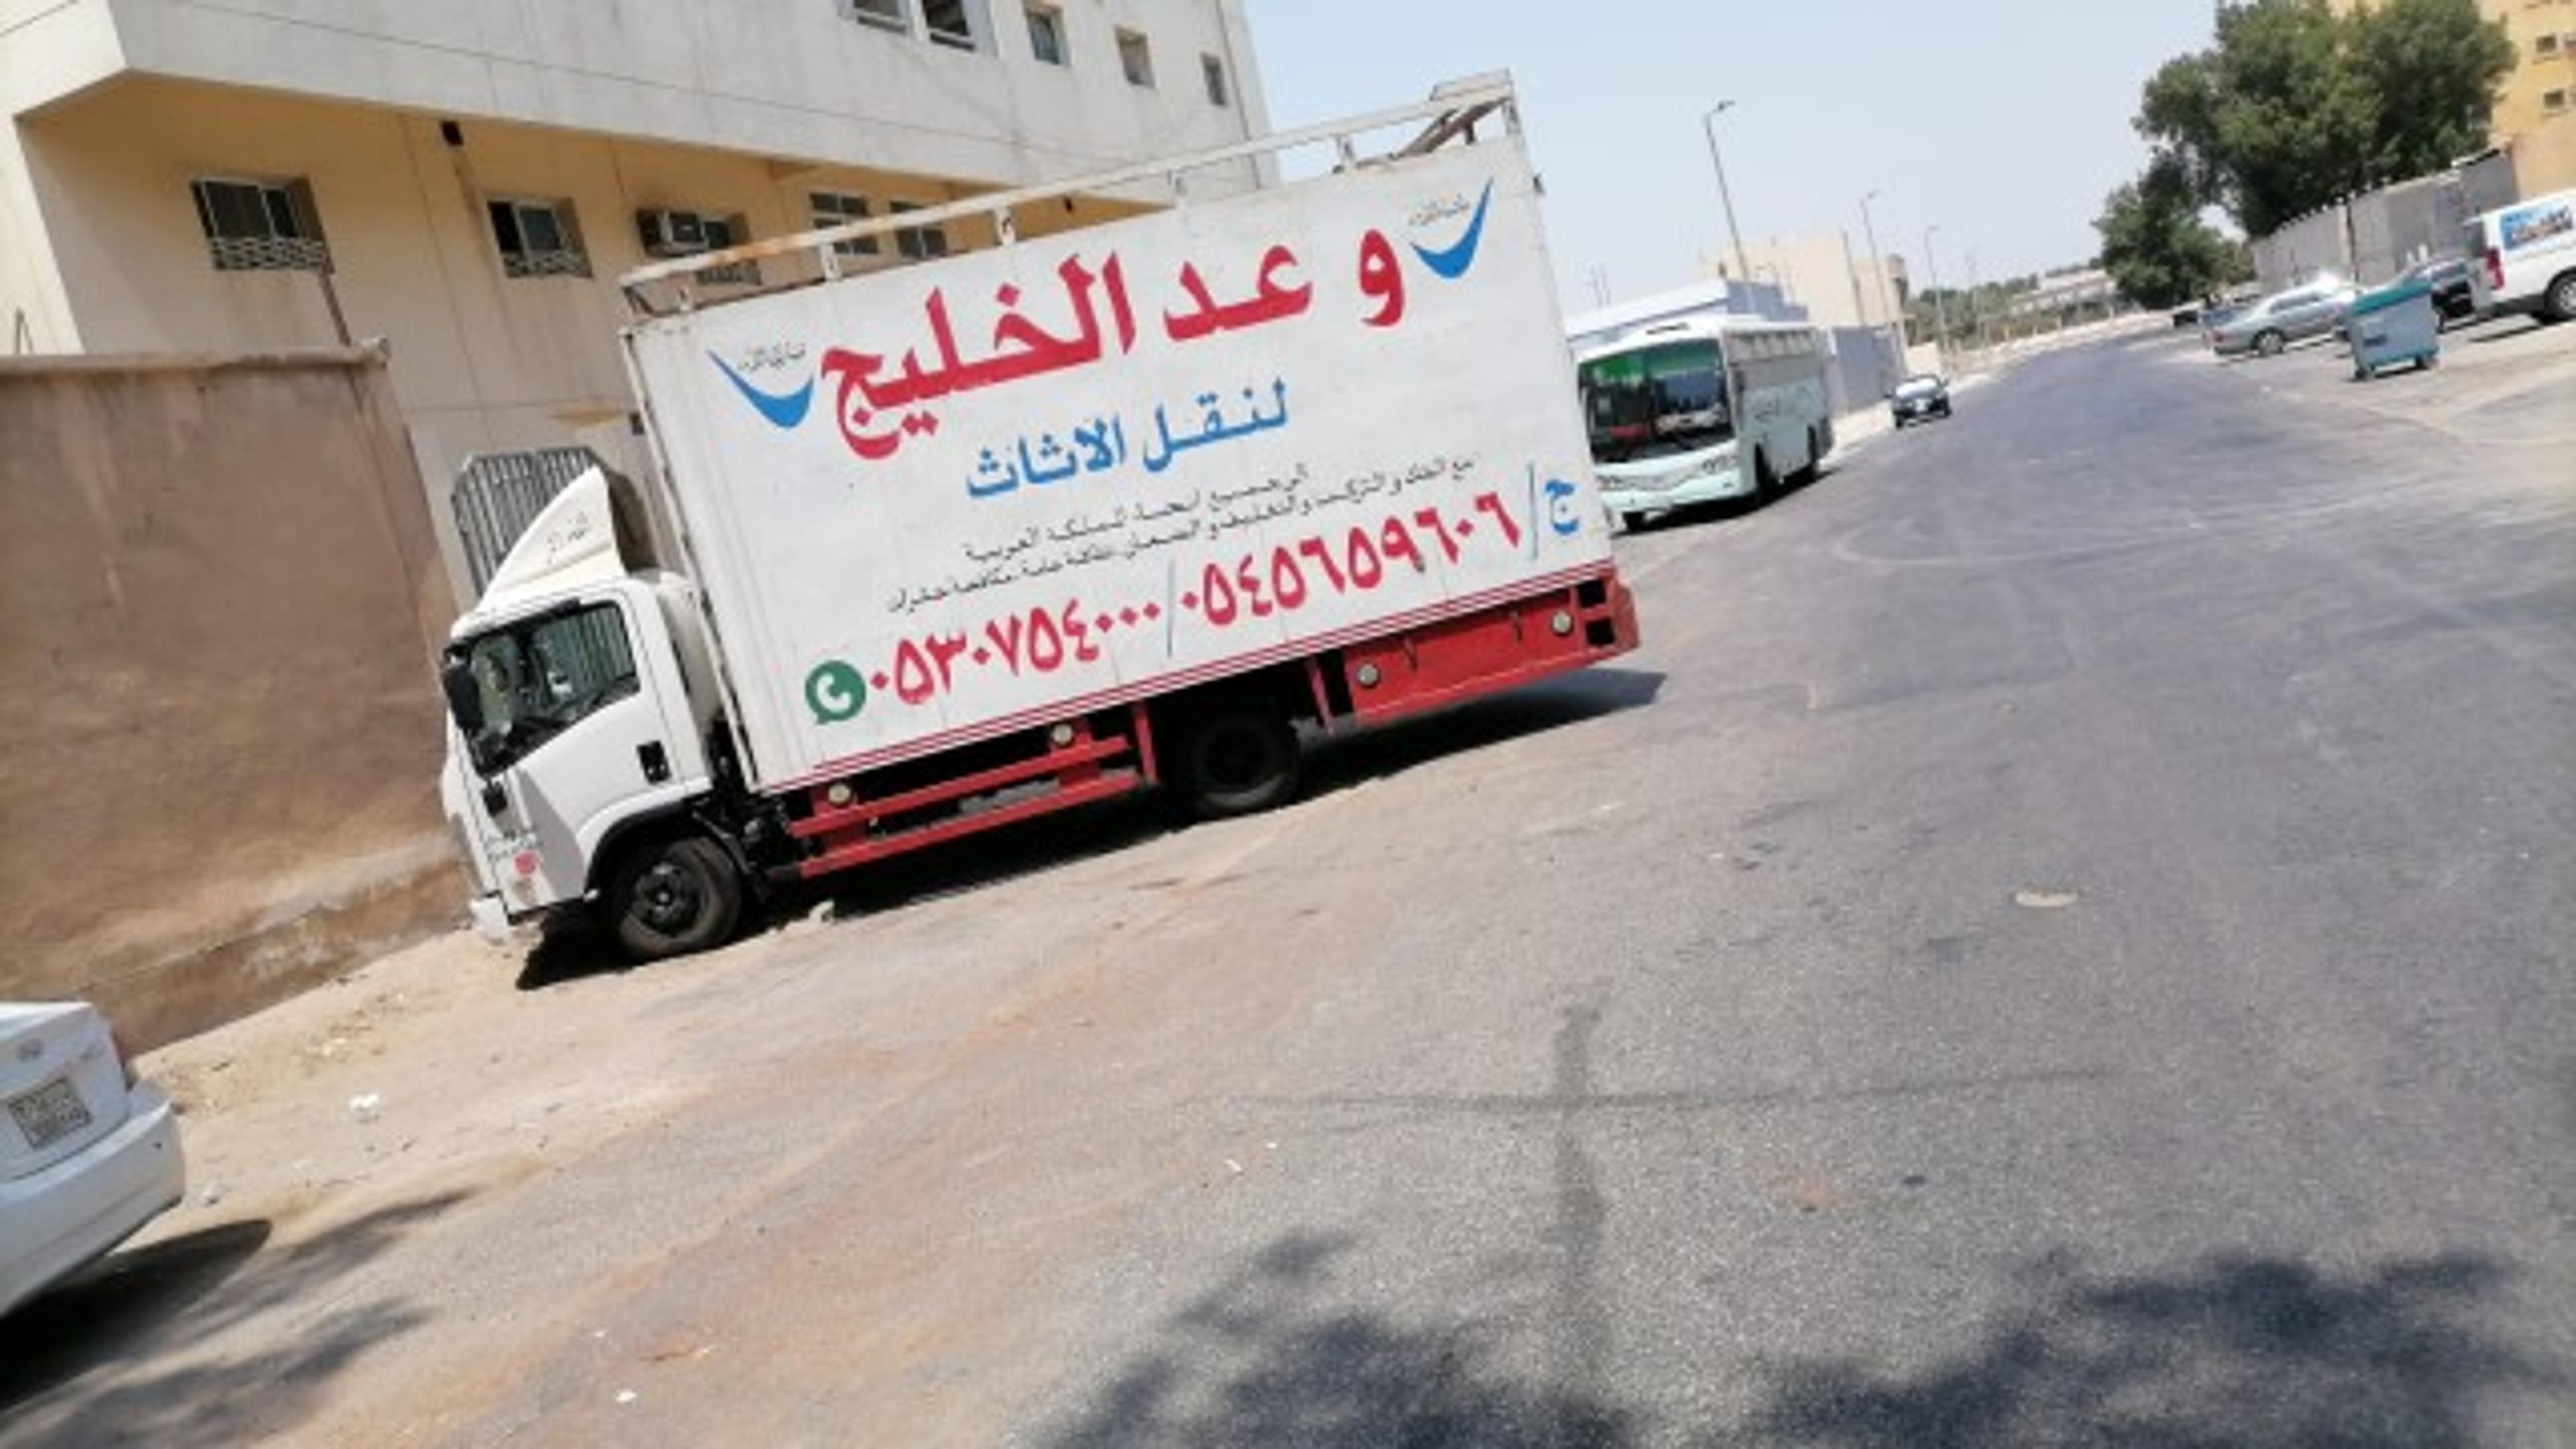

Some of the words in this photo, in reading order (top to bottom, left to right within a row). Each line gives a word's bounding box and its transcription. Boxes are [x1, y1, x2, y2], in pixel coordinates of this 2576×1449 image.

[819, 252, 1138, 462] الخليج
[965, 411, 1128, 500] الاثاث
[1141, 376, 1290, 474] لنقل
